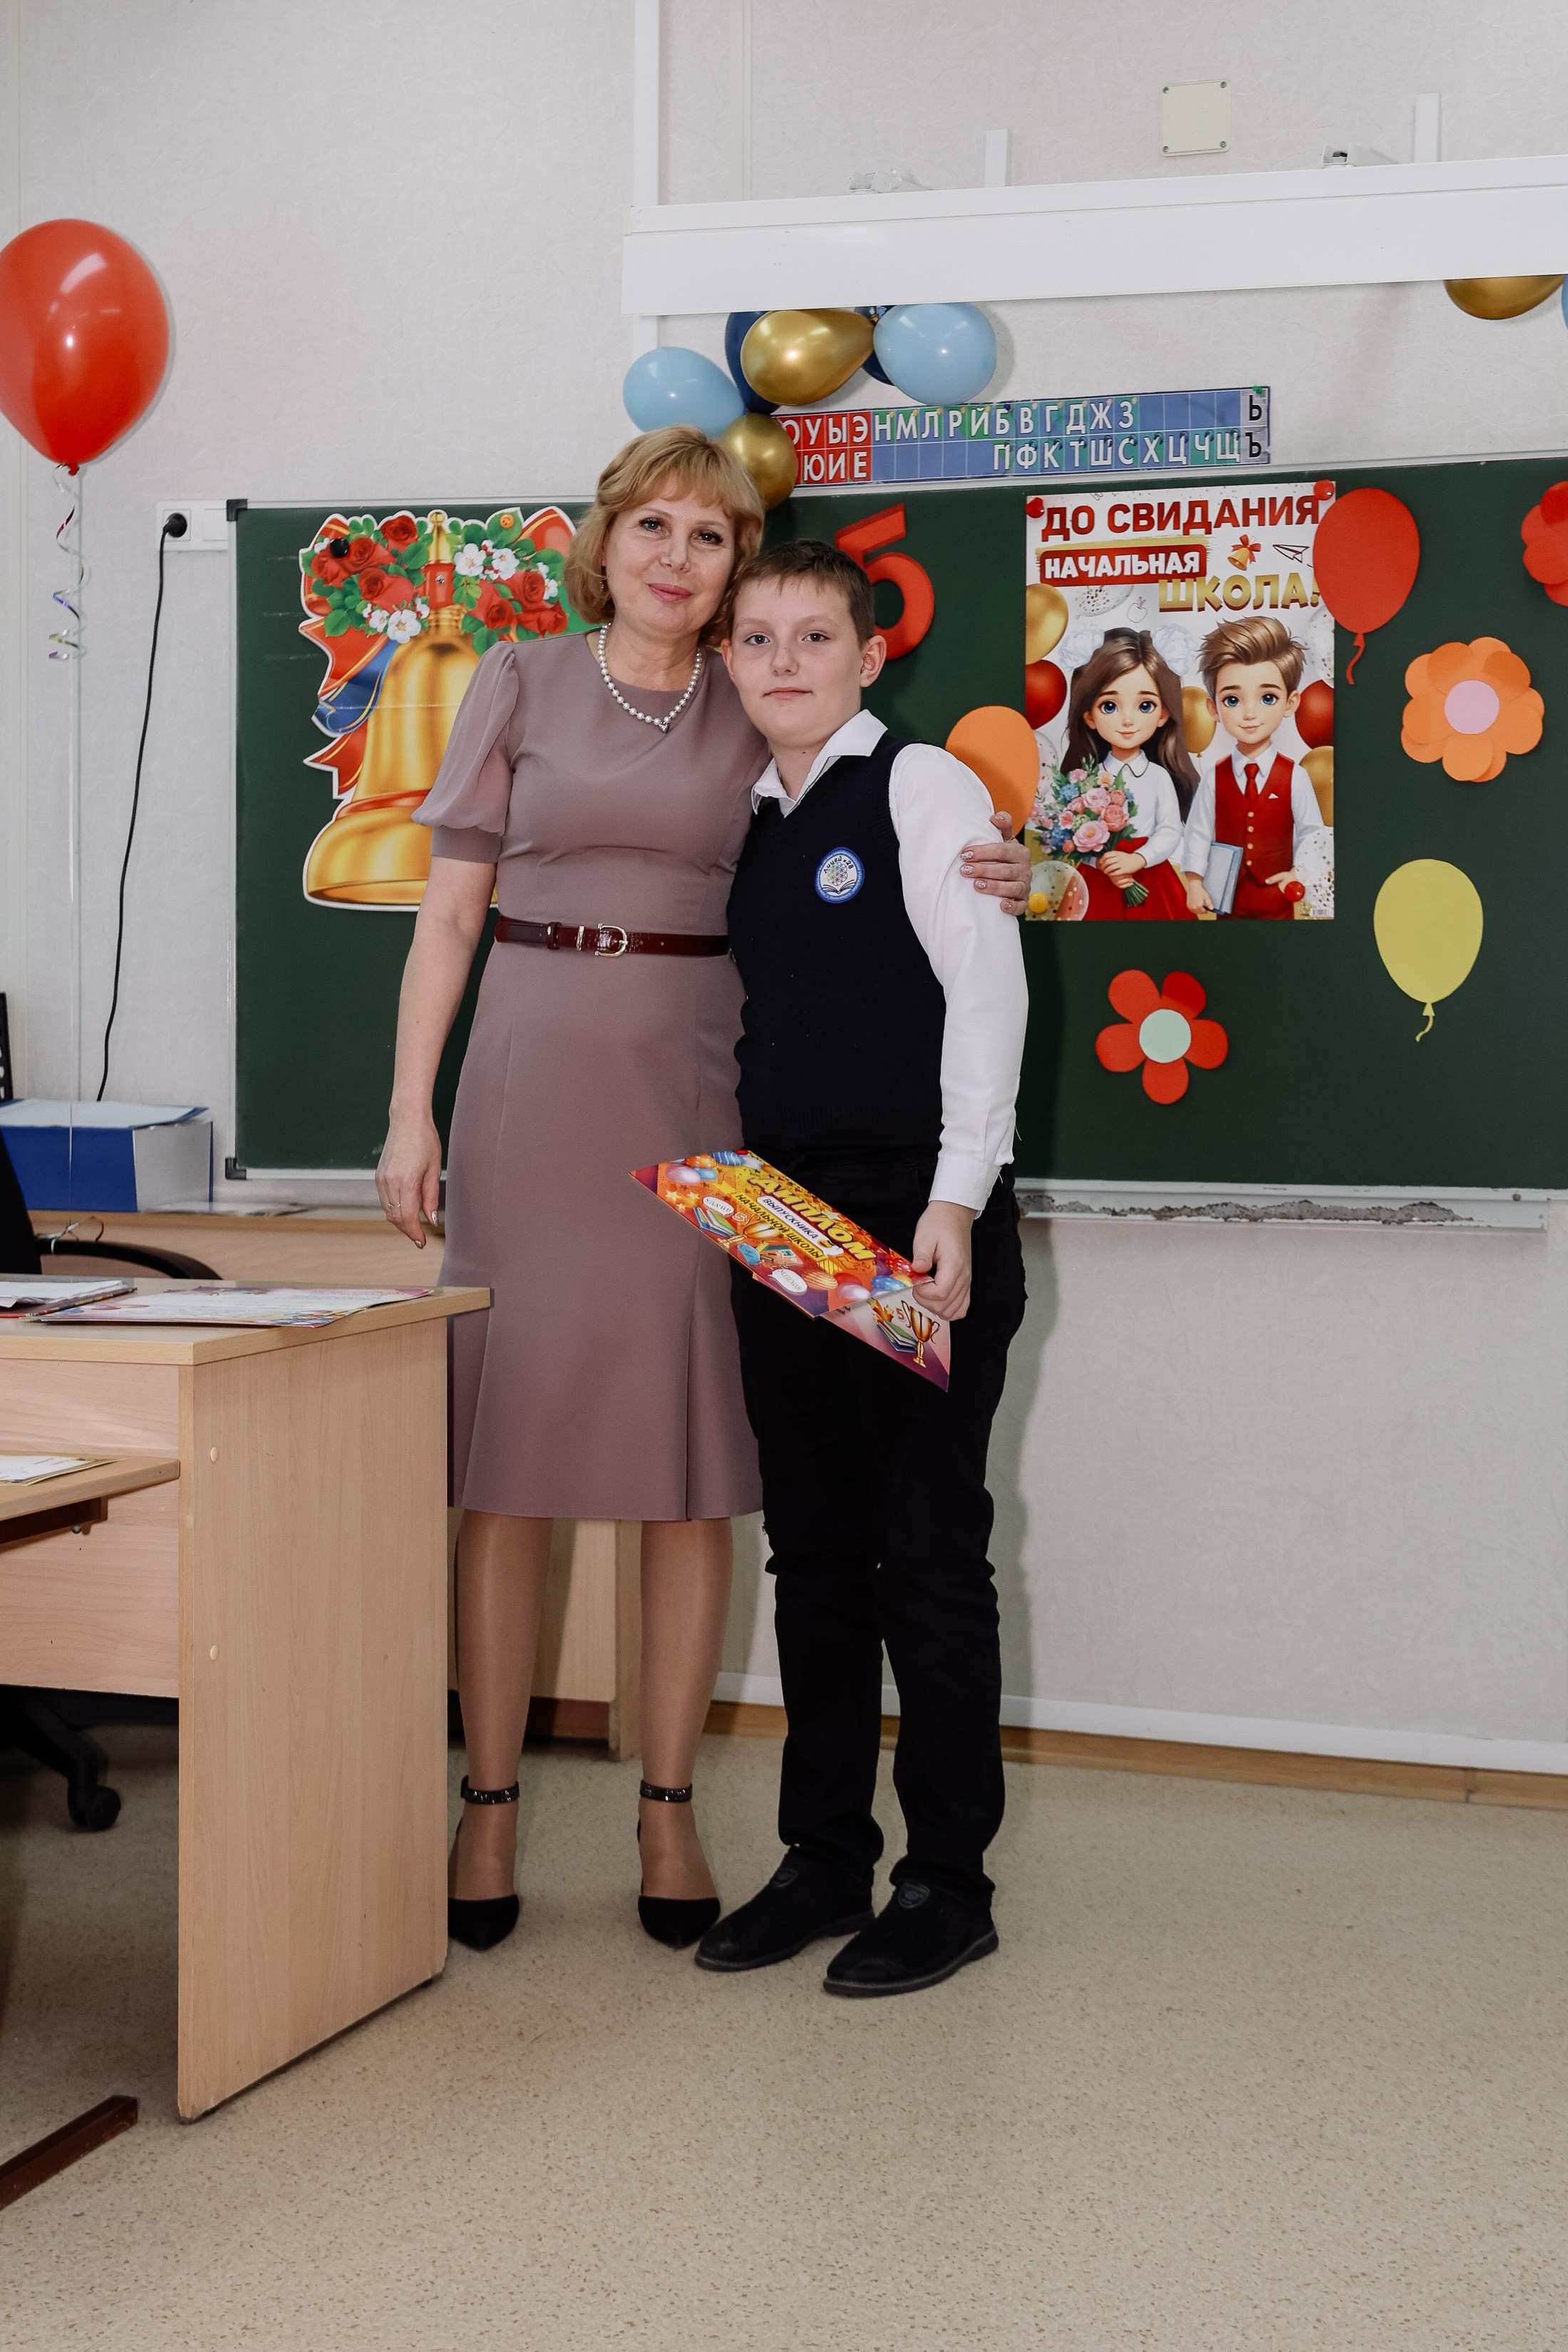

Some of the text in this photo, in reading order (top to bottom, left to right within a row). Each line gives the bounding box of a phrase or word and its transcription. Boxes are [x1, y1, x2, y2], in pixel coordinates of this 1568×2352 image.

[1041, 495, 1320, 542] ДО СВИДАНИЯ
[835, 502, 935, 661] 5
[1044, 552, 1200, 579] НАЧАЛЬНАЯ
[736, 1194, 789, 1233] НАЧАЛЬНОЙ
[786, 1232, 824, 1259] ШКОЛЫ
[747, 1177, 877, 1261] ДИПЛОМ
[763, 1198, 819, 1239] ВЫПУСКНИКА
